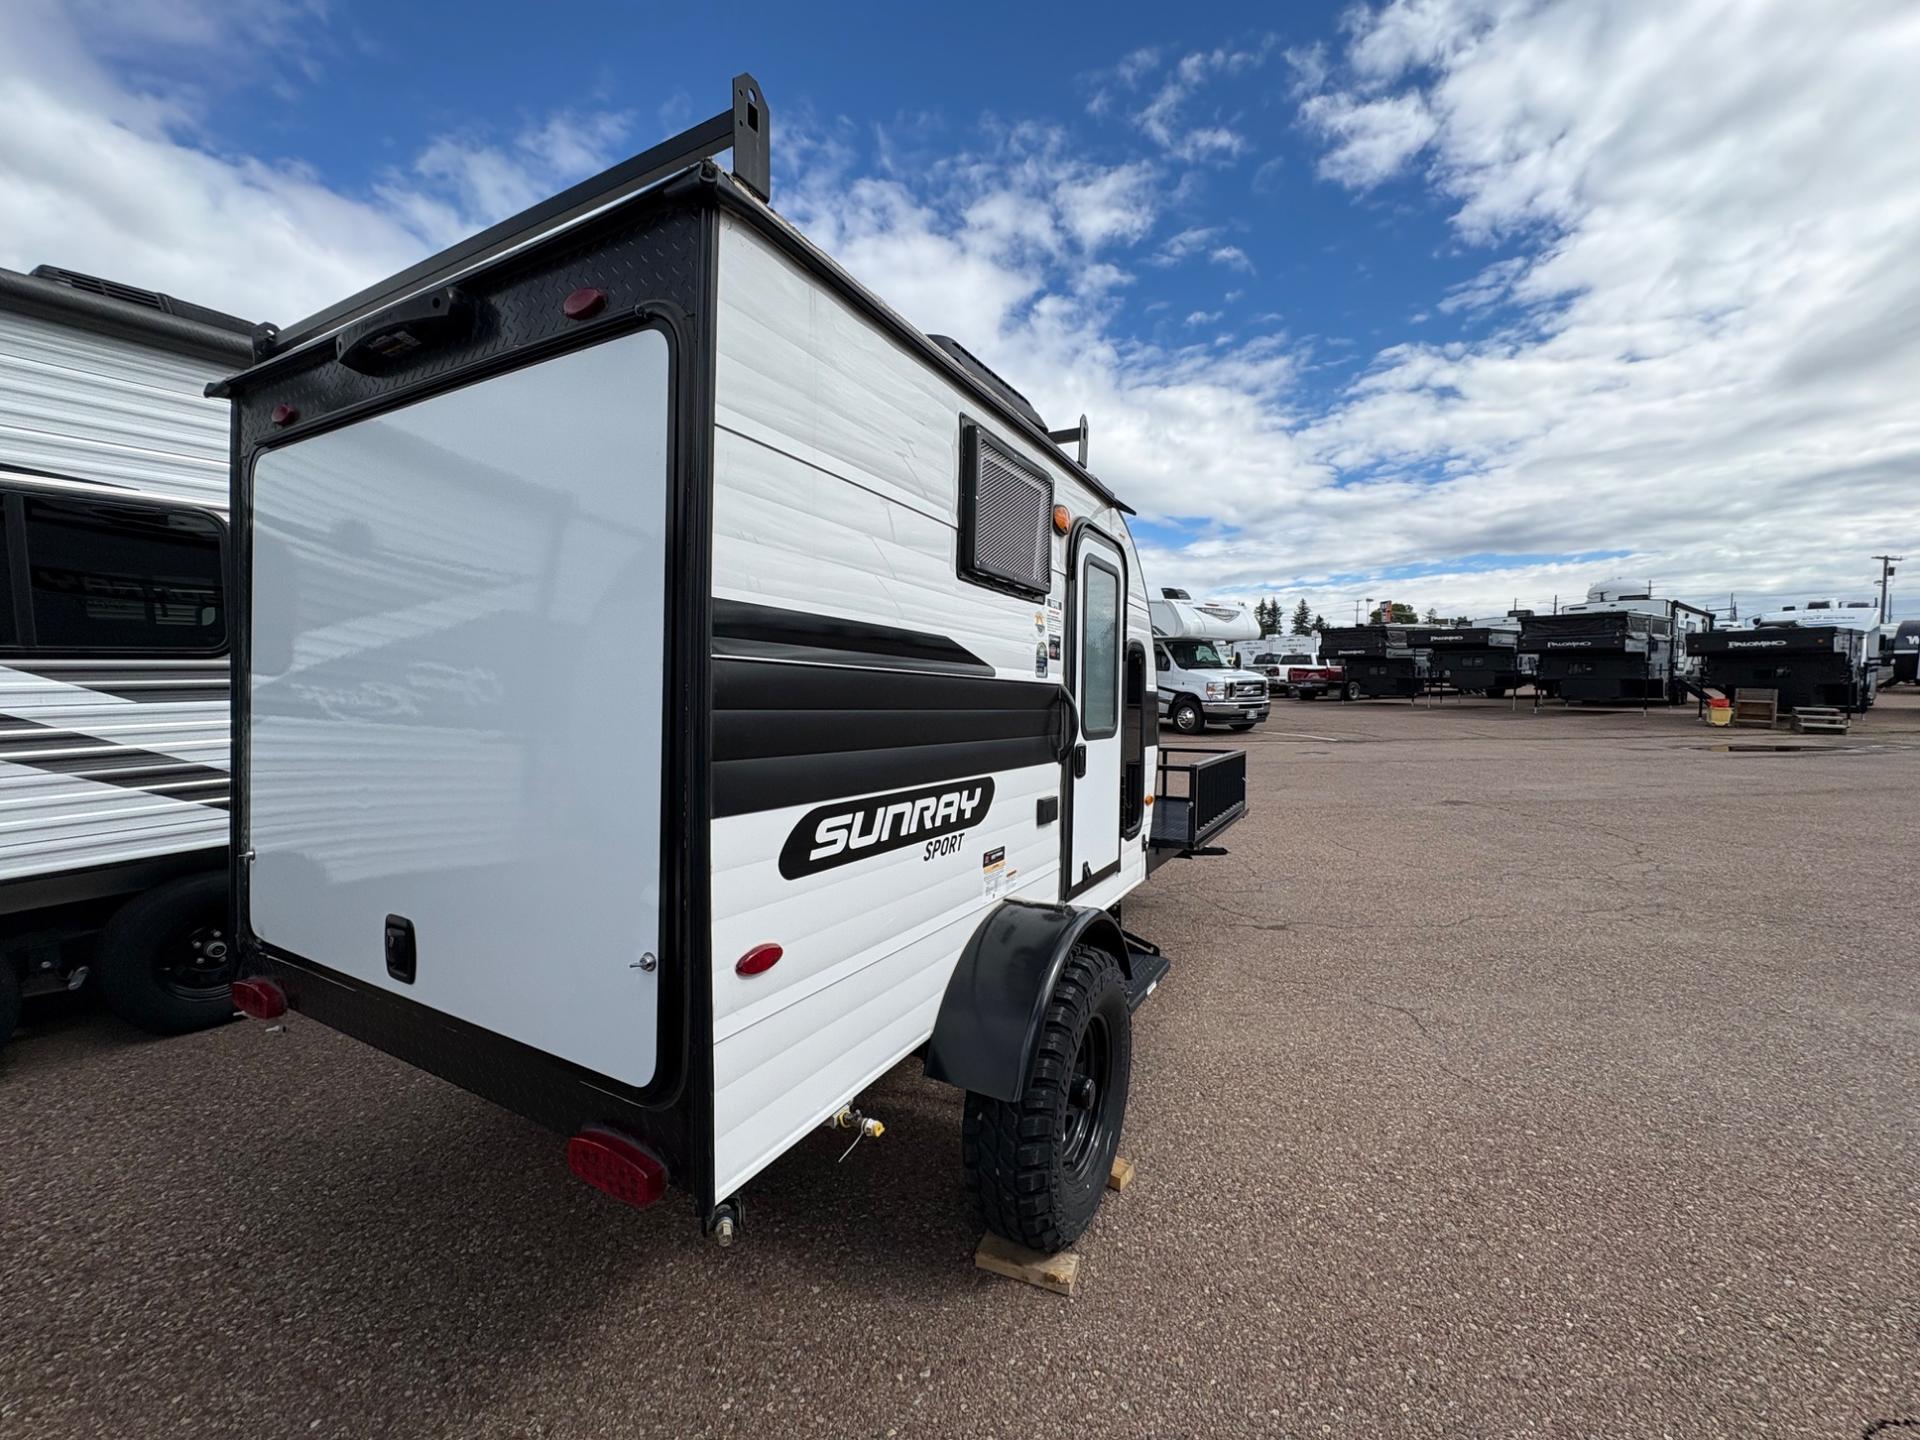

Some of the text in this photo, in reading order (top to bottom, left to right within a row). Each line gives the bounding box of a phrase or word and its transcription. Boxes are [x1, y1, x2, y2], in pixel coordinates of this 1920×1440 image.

[1727, 640, 1787, 649] PALOMINO
[809, 787, 982, 861] SUNRAY
[923, 832, 965, 862] SPORT
